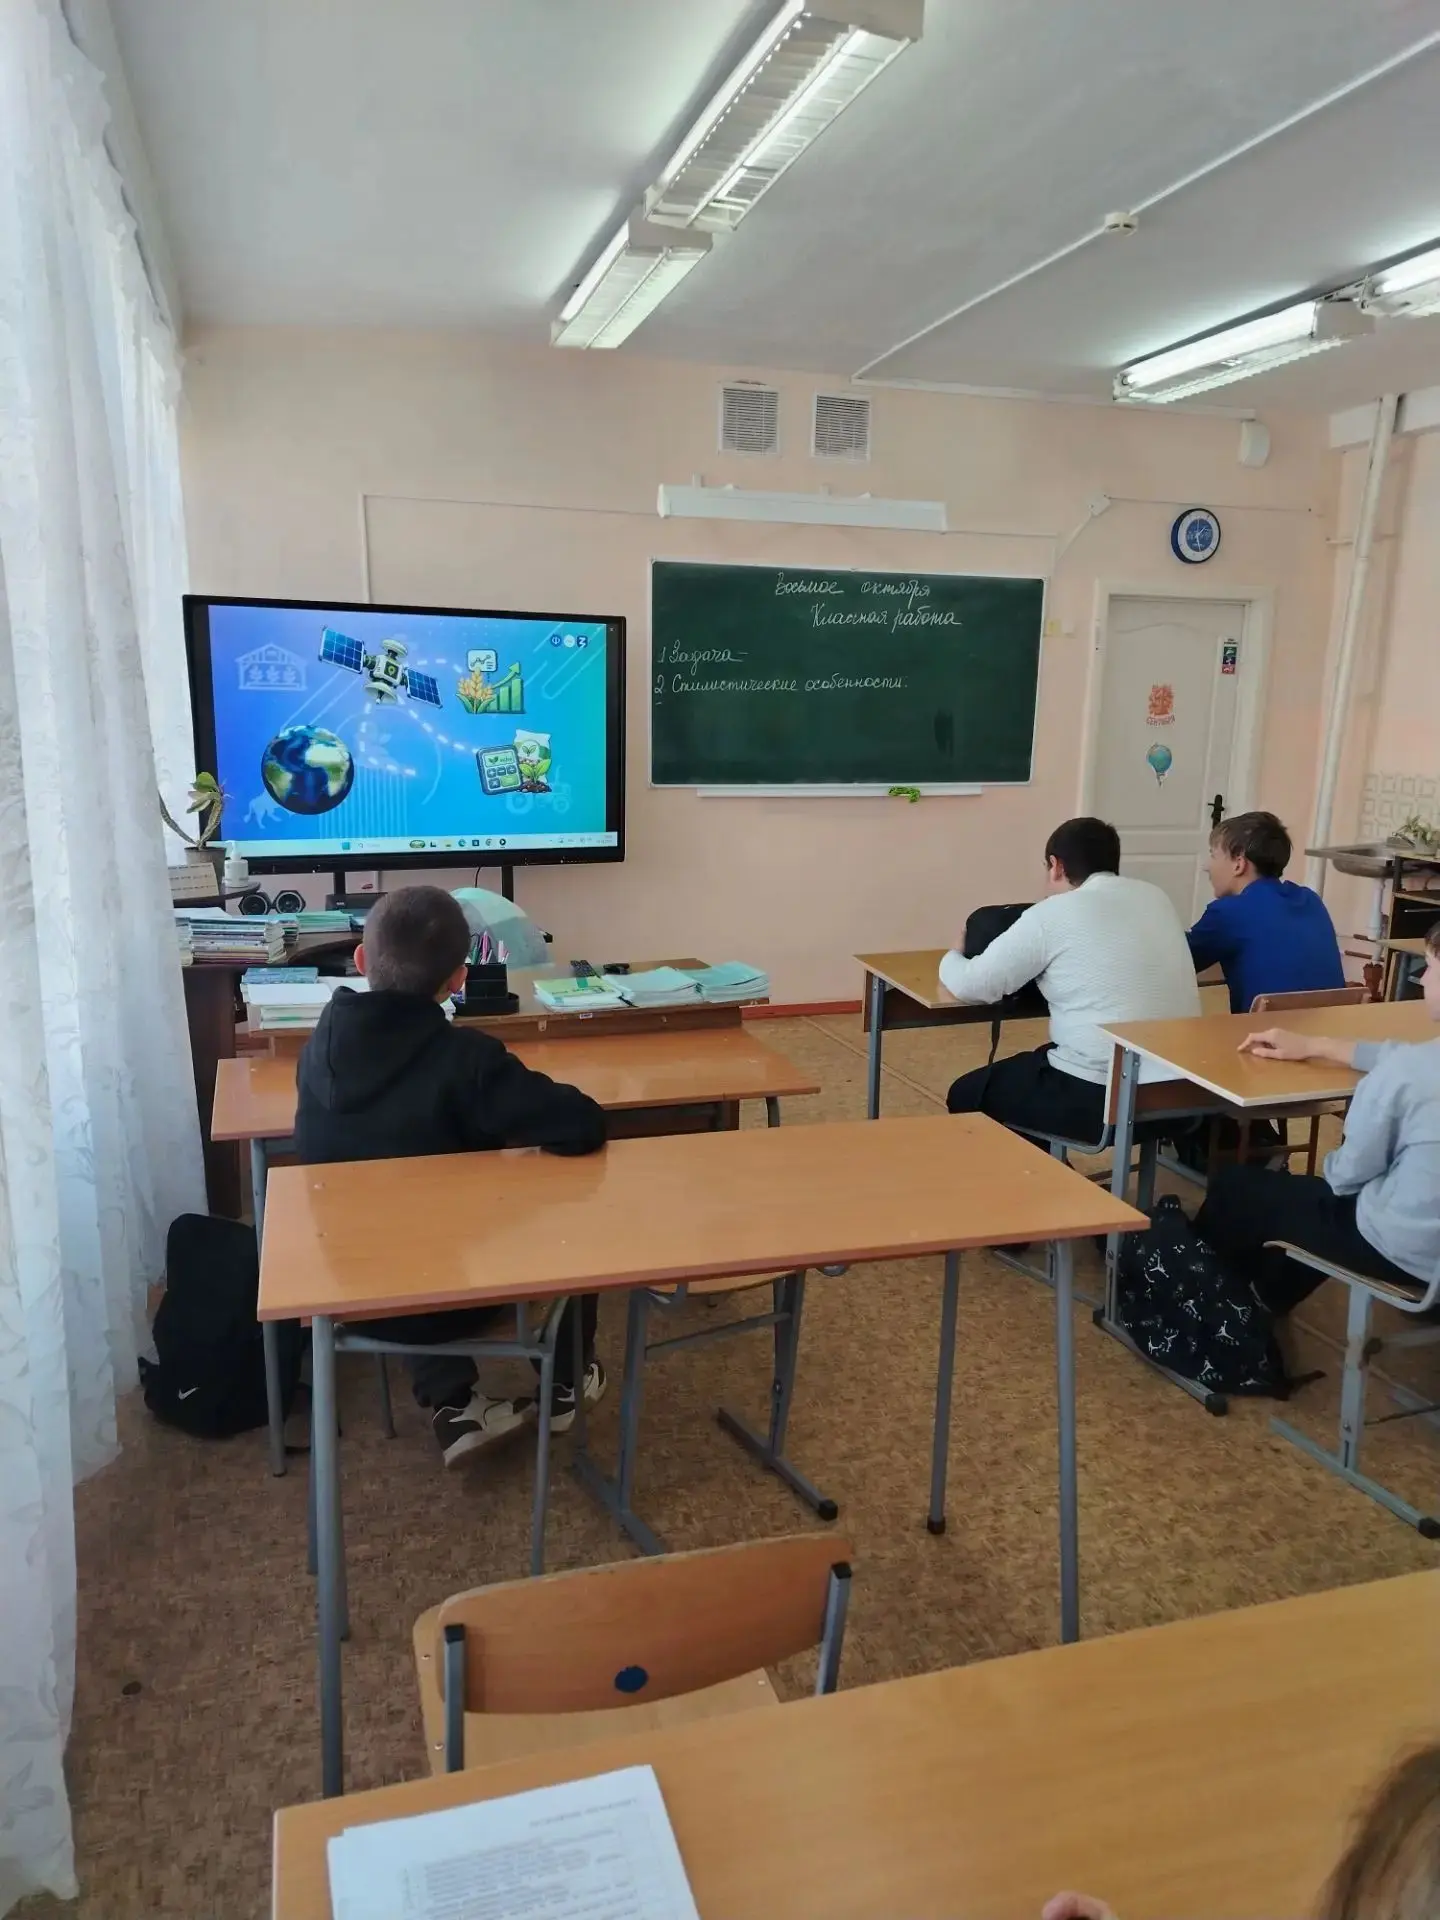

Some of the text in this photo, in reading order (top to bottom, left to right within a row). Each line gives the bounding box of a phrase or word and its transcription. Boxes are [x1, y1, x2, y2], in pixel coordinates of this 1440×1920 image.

[775, 571, 931, 610] Восьмое октября
[891, 606, 962, 633] работа
[672, 673, 799, 693] Стилистические
